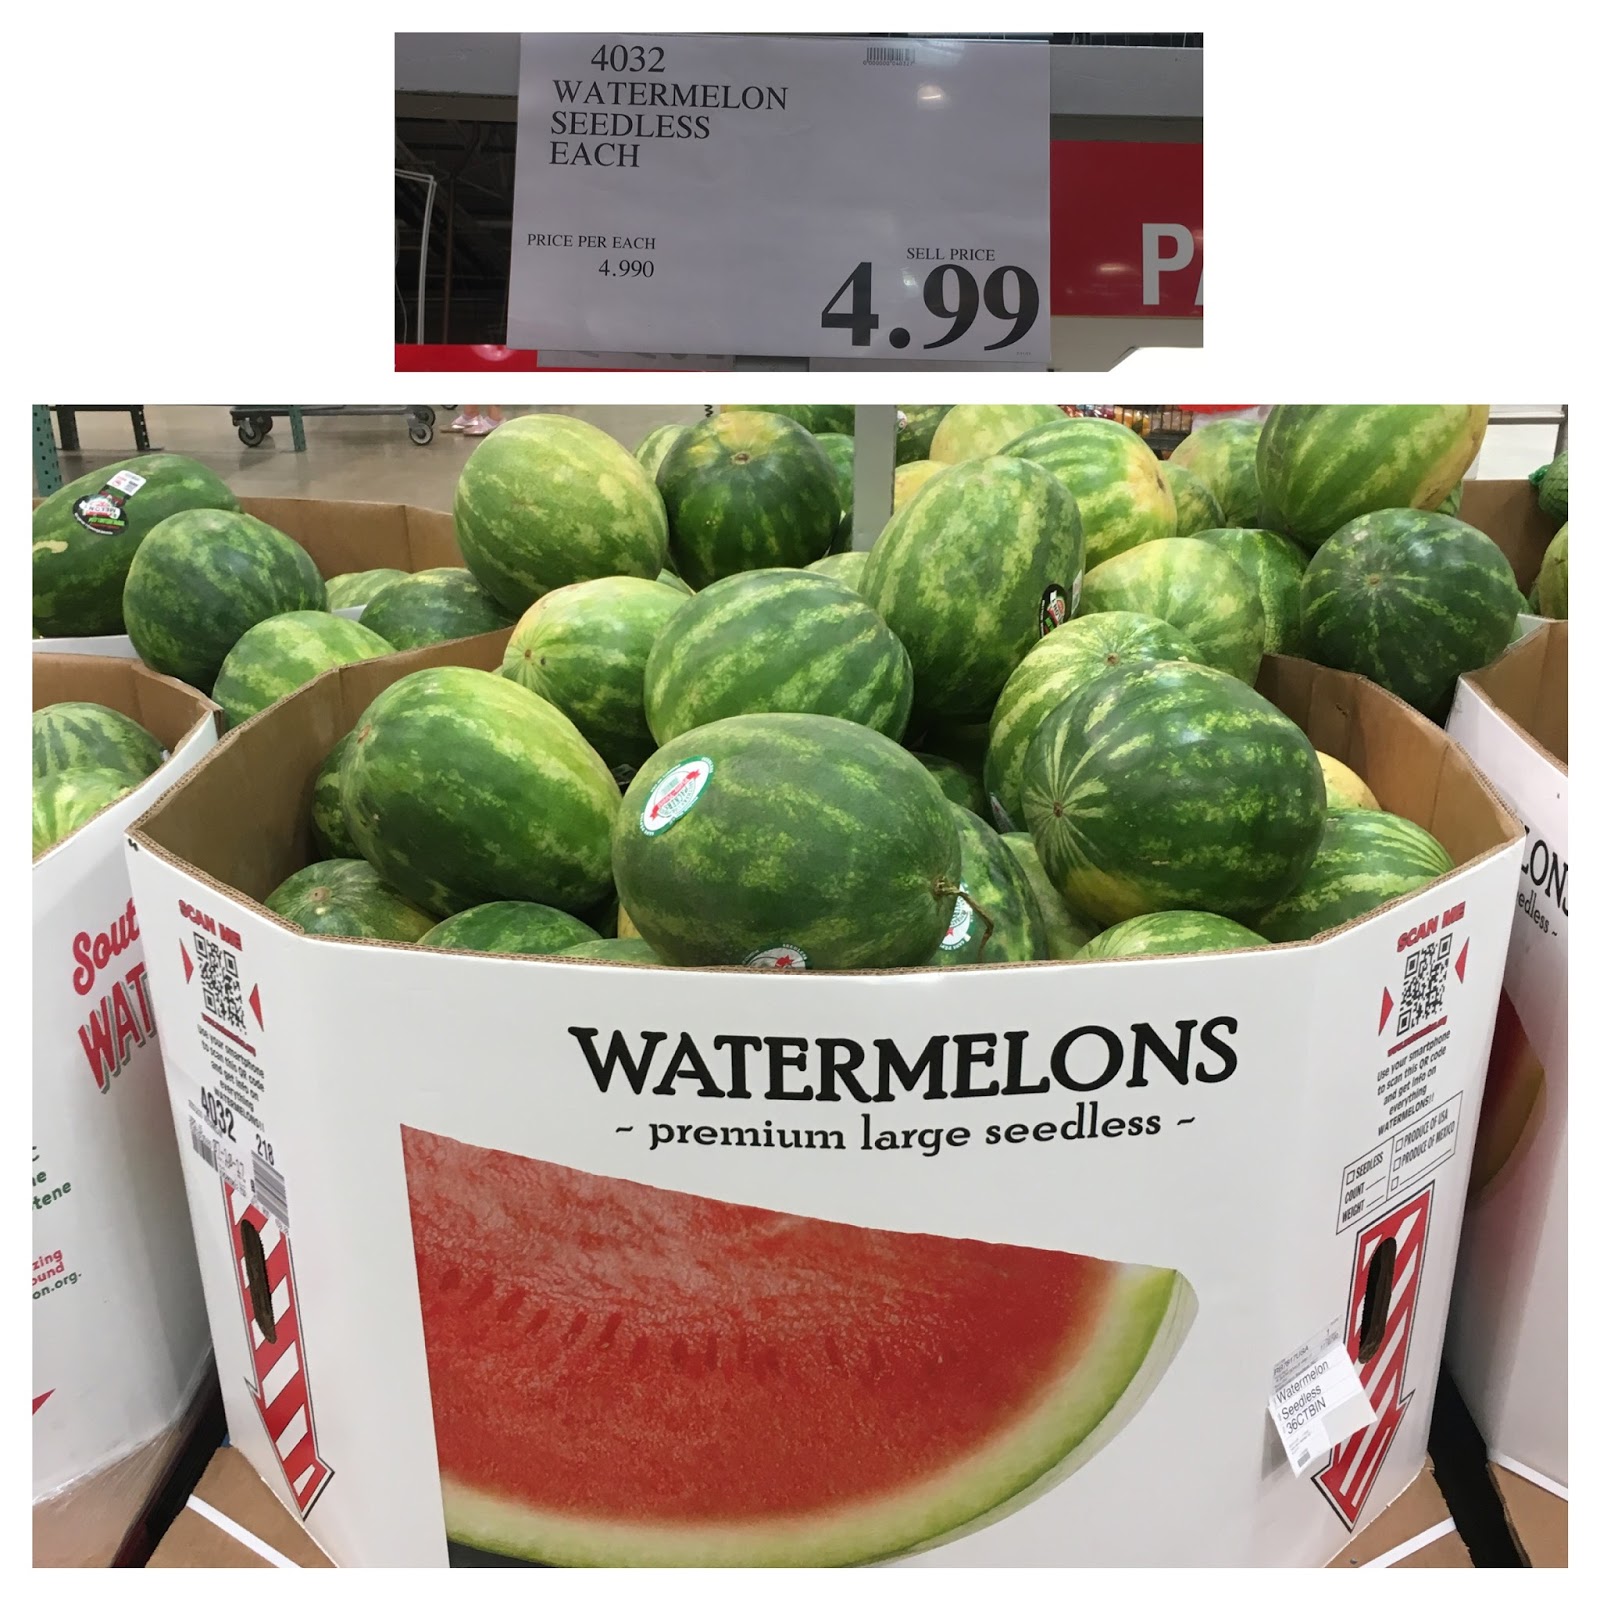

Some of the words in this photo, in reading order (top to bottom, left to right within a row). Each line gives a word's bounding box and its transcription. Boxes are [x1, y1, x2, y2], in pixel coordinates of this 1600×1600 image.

[591, 44, 666, 73] 4032
[552, 79, 789, 111] WATERMELON
[550, 110, 711, 139] SEEDLESS
[549, 141, 641, 168] EACH
[527, 233, 574, 247] PRICE
[577, 235, 608, 249] PER
[612, 236, 657, 250] EACH
[906, 247, 945, 261] SELL
[949, 248, 996, 262] PRICE
[598, 258, 655, 278] 4.990
[1142, 222, 1204, 306] P
[820, 261, 1040, 352] 4.99
[1520, 825, 1568, 917] ON
[178, 899, 217, 936] SCAN
[218, 922, 243, 952] ME
[1396, 915, 1440, 953] SCAN
[1441, 900, 1466, 930] ME
[1518, 889, 1550, 933] edless
[567, 1015, 1239, 1104] WATERMELONS
[1377, 1084, 1386, 1097] to
[1386, 1073, 1403, 1090] scan
[1404, 1062, 1418, 1079] this
[1419, 1055, 1430, 1071] QR
[1430, 1045, 1447, 1063] code
[1391, 1055, 1408, 1075] your
[1408, 1029, 1451, 1062] smartphone
[1383, 1088, 1397, 1106] and
[1398, 1081, 1411, 1098] get
[1411, 1070, 1426, 1088] info
[1427, 1065, 1437, 1078] on
[1389, 1085, 1428, 1116] everything
[201, 1086, 237, 1143] 4032
[648, 1119, 846, 1152] premium
[861, 1113, 971, 1157] large
[985, 1102, 1162, 1146] seedless
[1403, 1120, 1430, 1148] PRODUCE
[1430, 1115, 1438, 1131] OF
[1438, 1108, 1449, 1125] USA
[255, 1133, 275, 1166] 218
[1401, 1139, 1428, 1167] PRODUCE
[1427, 1134, 1435, 1150] OF
[1435, 1120, 1456, 1142] MEXICO
[1355, 1151, 1384, 1180] SEEDLESS
[1342, 1198, 1366, 1224] WEIGHT
[1344, 1181, 1366, 1205] COUNT
[32, 1249, 63, 1271] zing
[1276, 1360, 1329, 1404] Watermelon
[1281, 1384, 1322, 1421] Seedless
[1286, 1396, 1327, 1435] 36CTBIN
